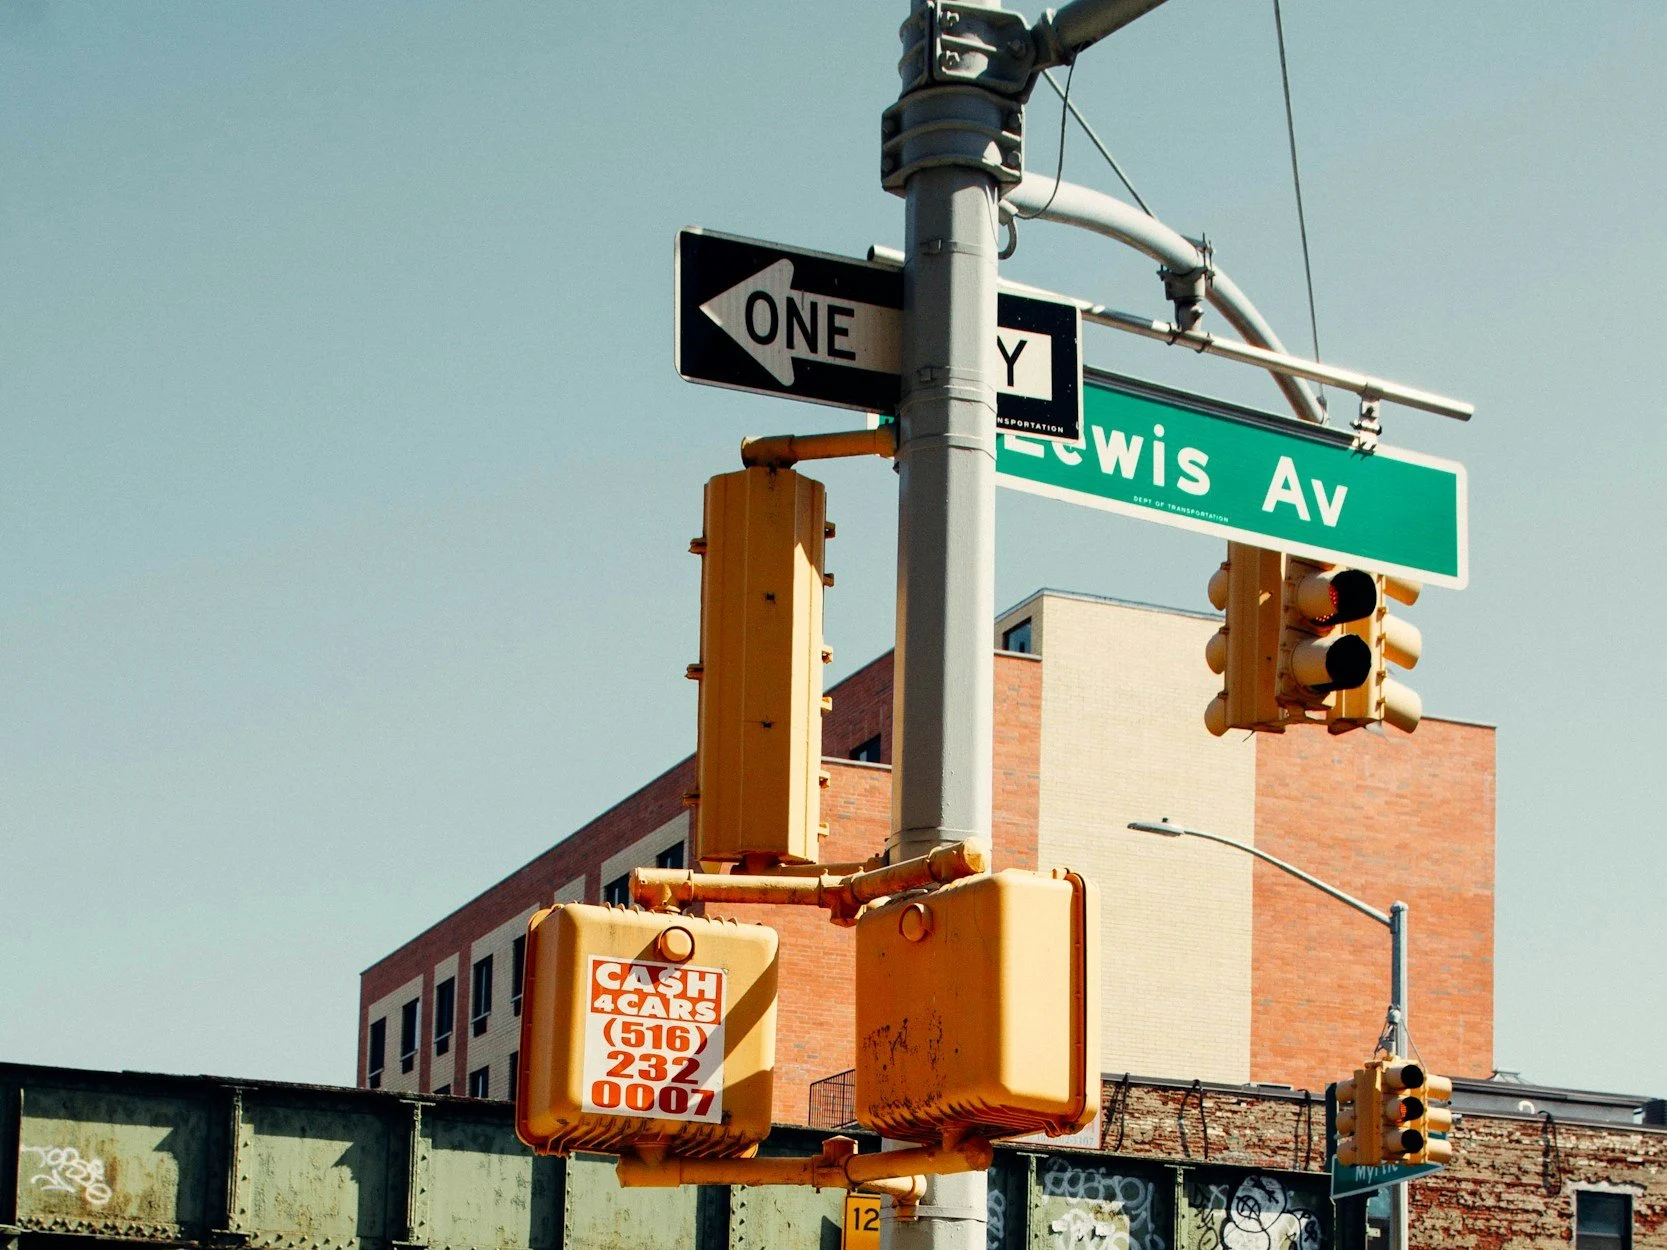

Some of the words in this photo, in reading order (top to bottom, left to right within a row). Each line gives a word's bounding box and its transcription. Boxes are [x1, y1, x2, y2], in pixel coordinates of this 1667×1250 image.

[745, 290, 856, 361] ONE
[1133, 495, 1152, 505] DEPT
[1168, 503, 1229, 523] TRANSPORTATION
[1262, 455, 1348, 527] Av
[594, 993, 717, 1024] 4CARS
[603, 1017, 708, 1055] (516)
[606, 1050, 701, 1085] 232
[591, 1080, 715, 1116] 0007
